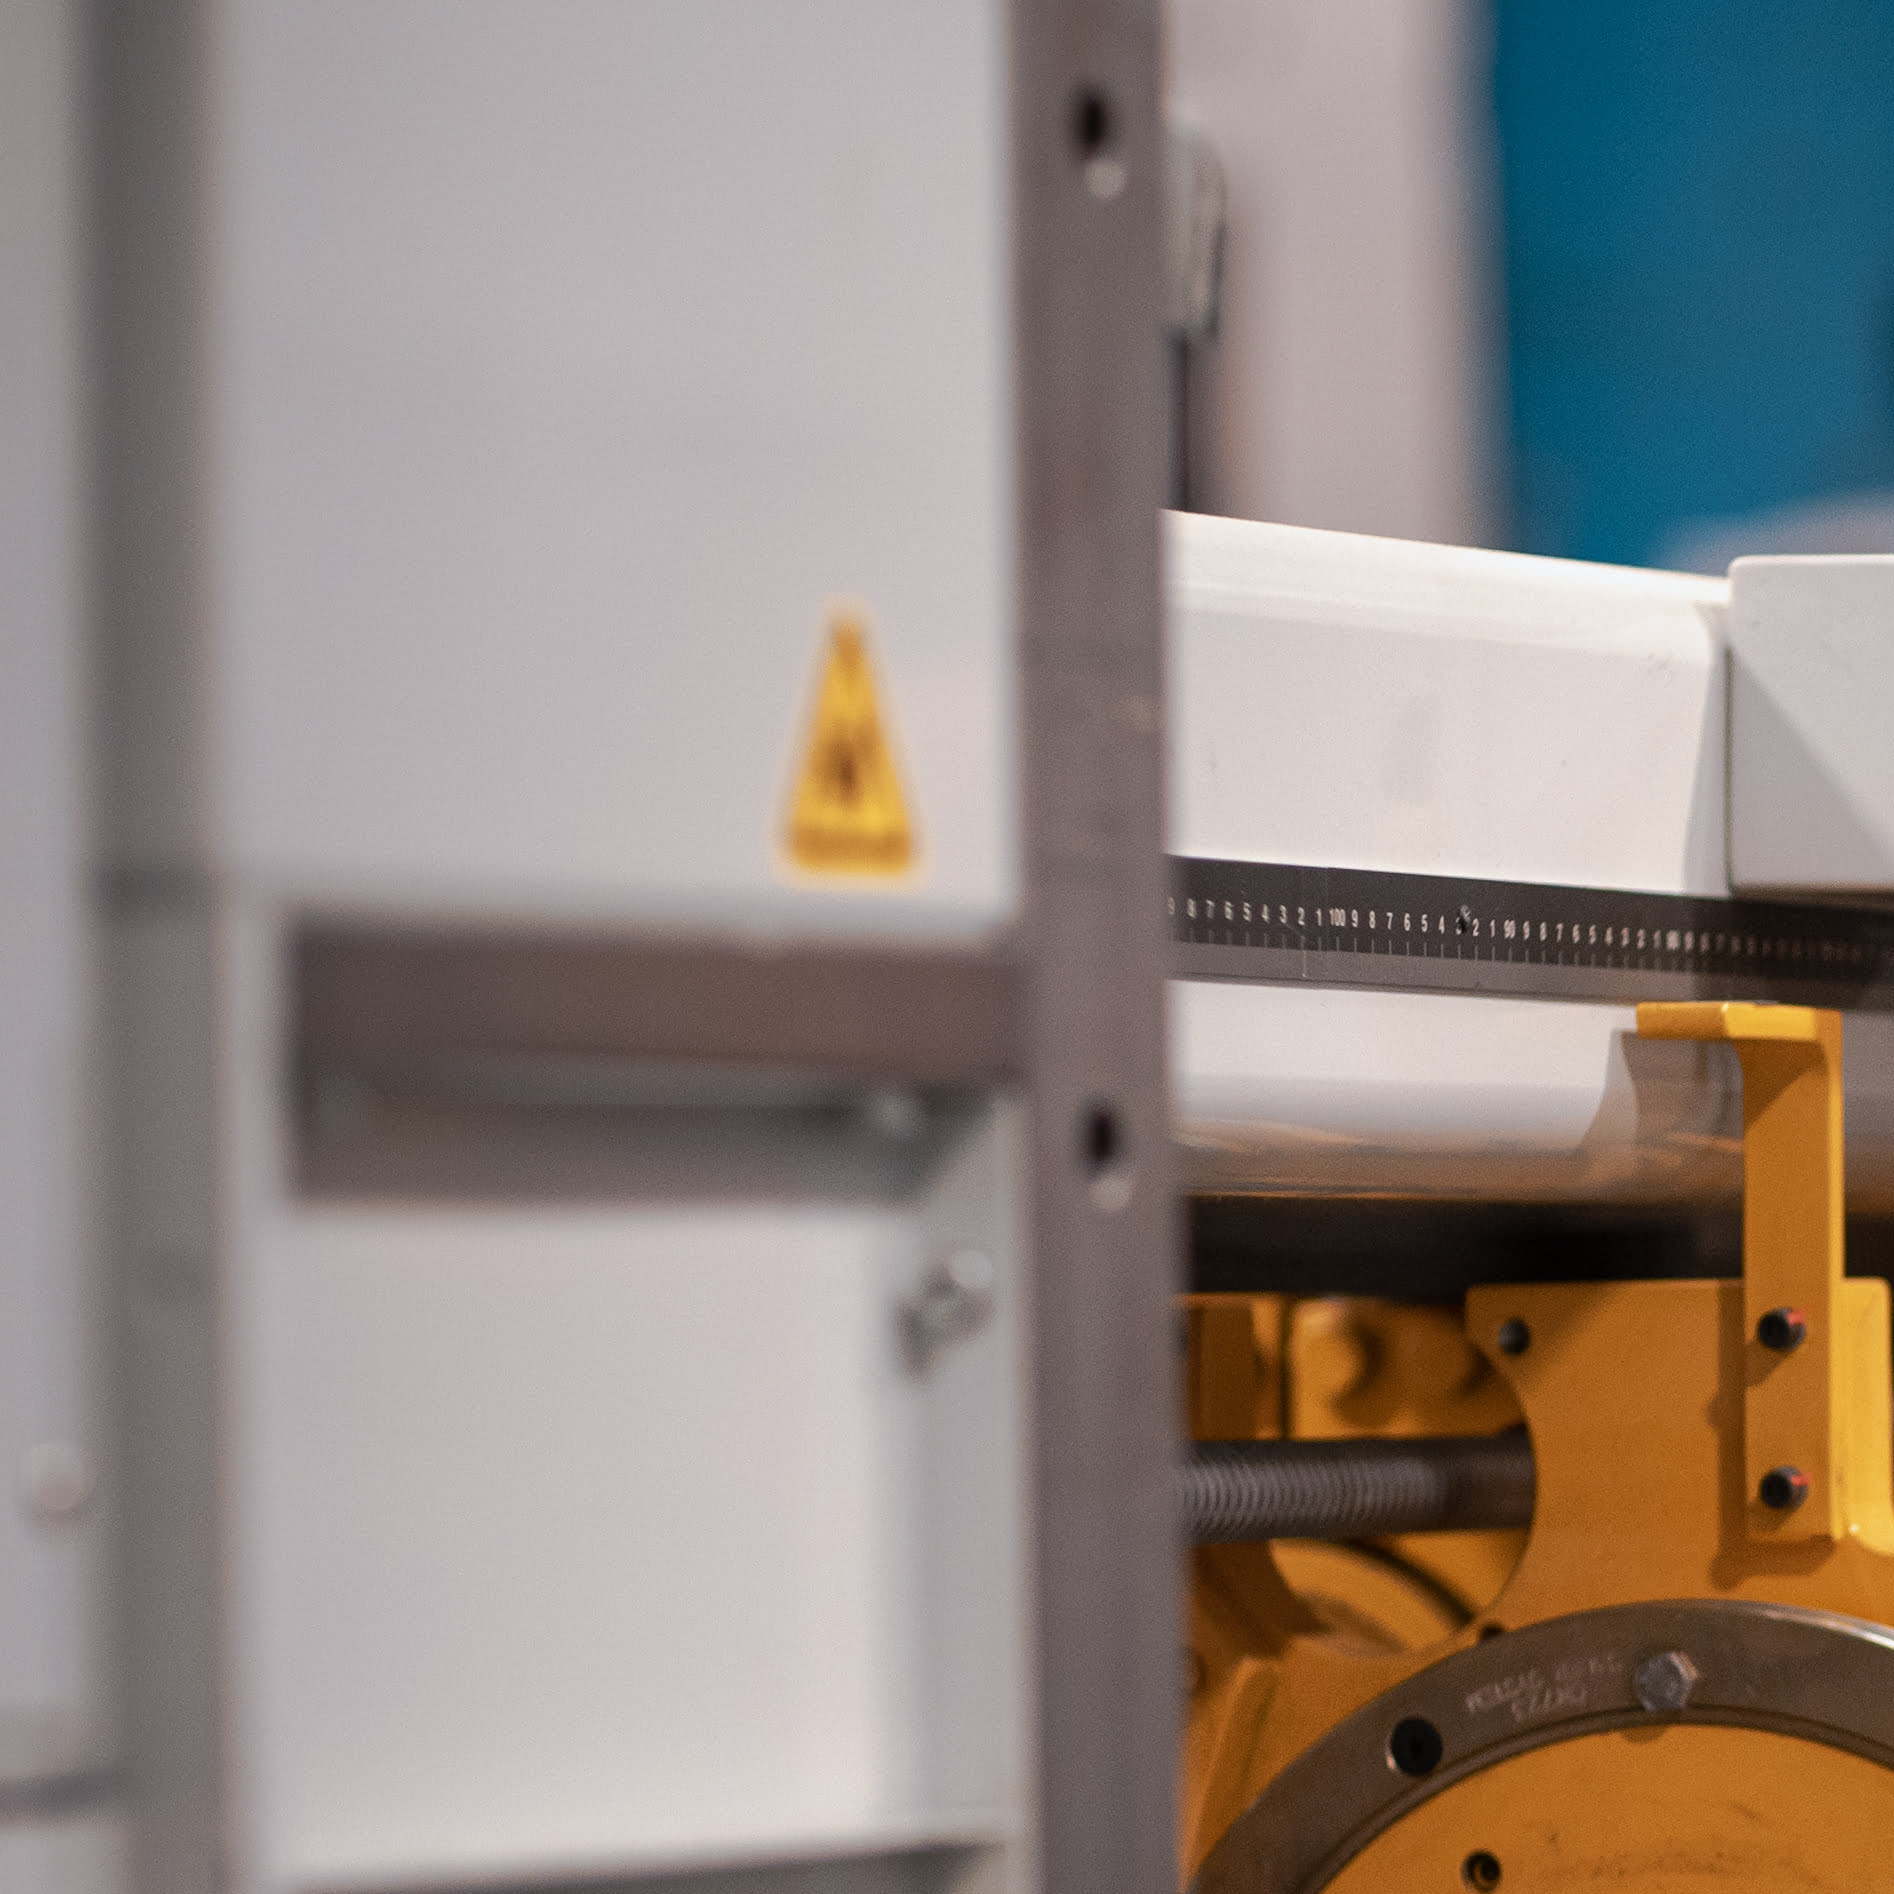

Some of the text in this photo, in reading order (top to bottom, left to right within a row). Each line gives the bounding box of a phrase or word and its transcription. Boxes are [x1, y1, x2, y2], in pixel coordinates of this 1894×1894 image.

[1206, 900, 1215, 919] 7
[1243, 902, 1251, 921] 5
[1261, 904, 1269, 923] 4
[1280, 905, 1287, 924] 3
[1298, 907, 1305, 926] 2
[1316, 908, 1322, 926] 1
[1329, 908, 1346, 926] 100
[1351, 909, 1358, 928] 9
[1369, 910, 1376, 929] 8
[1386, 912, 1393, 930] 7
[1404, 913, 1411, 931] 6
[1421, 914, 1428, 932] 5
[1438, 915, 1445, 934] 4
[1472, 918, 1479, 936] 2
[1489, 919, 1496, 938] 1
